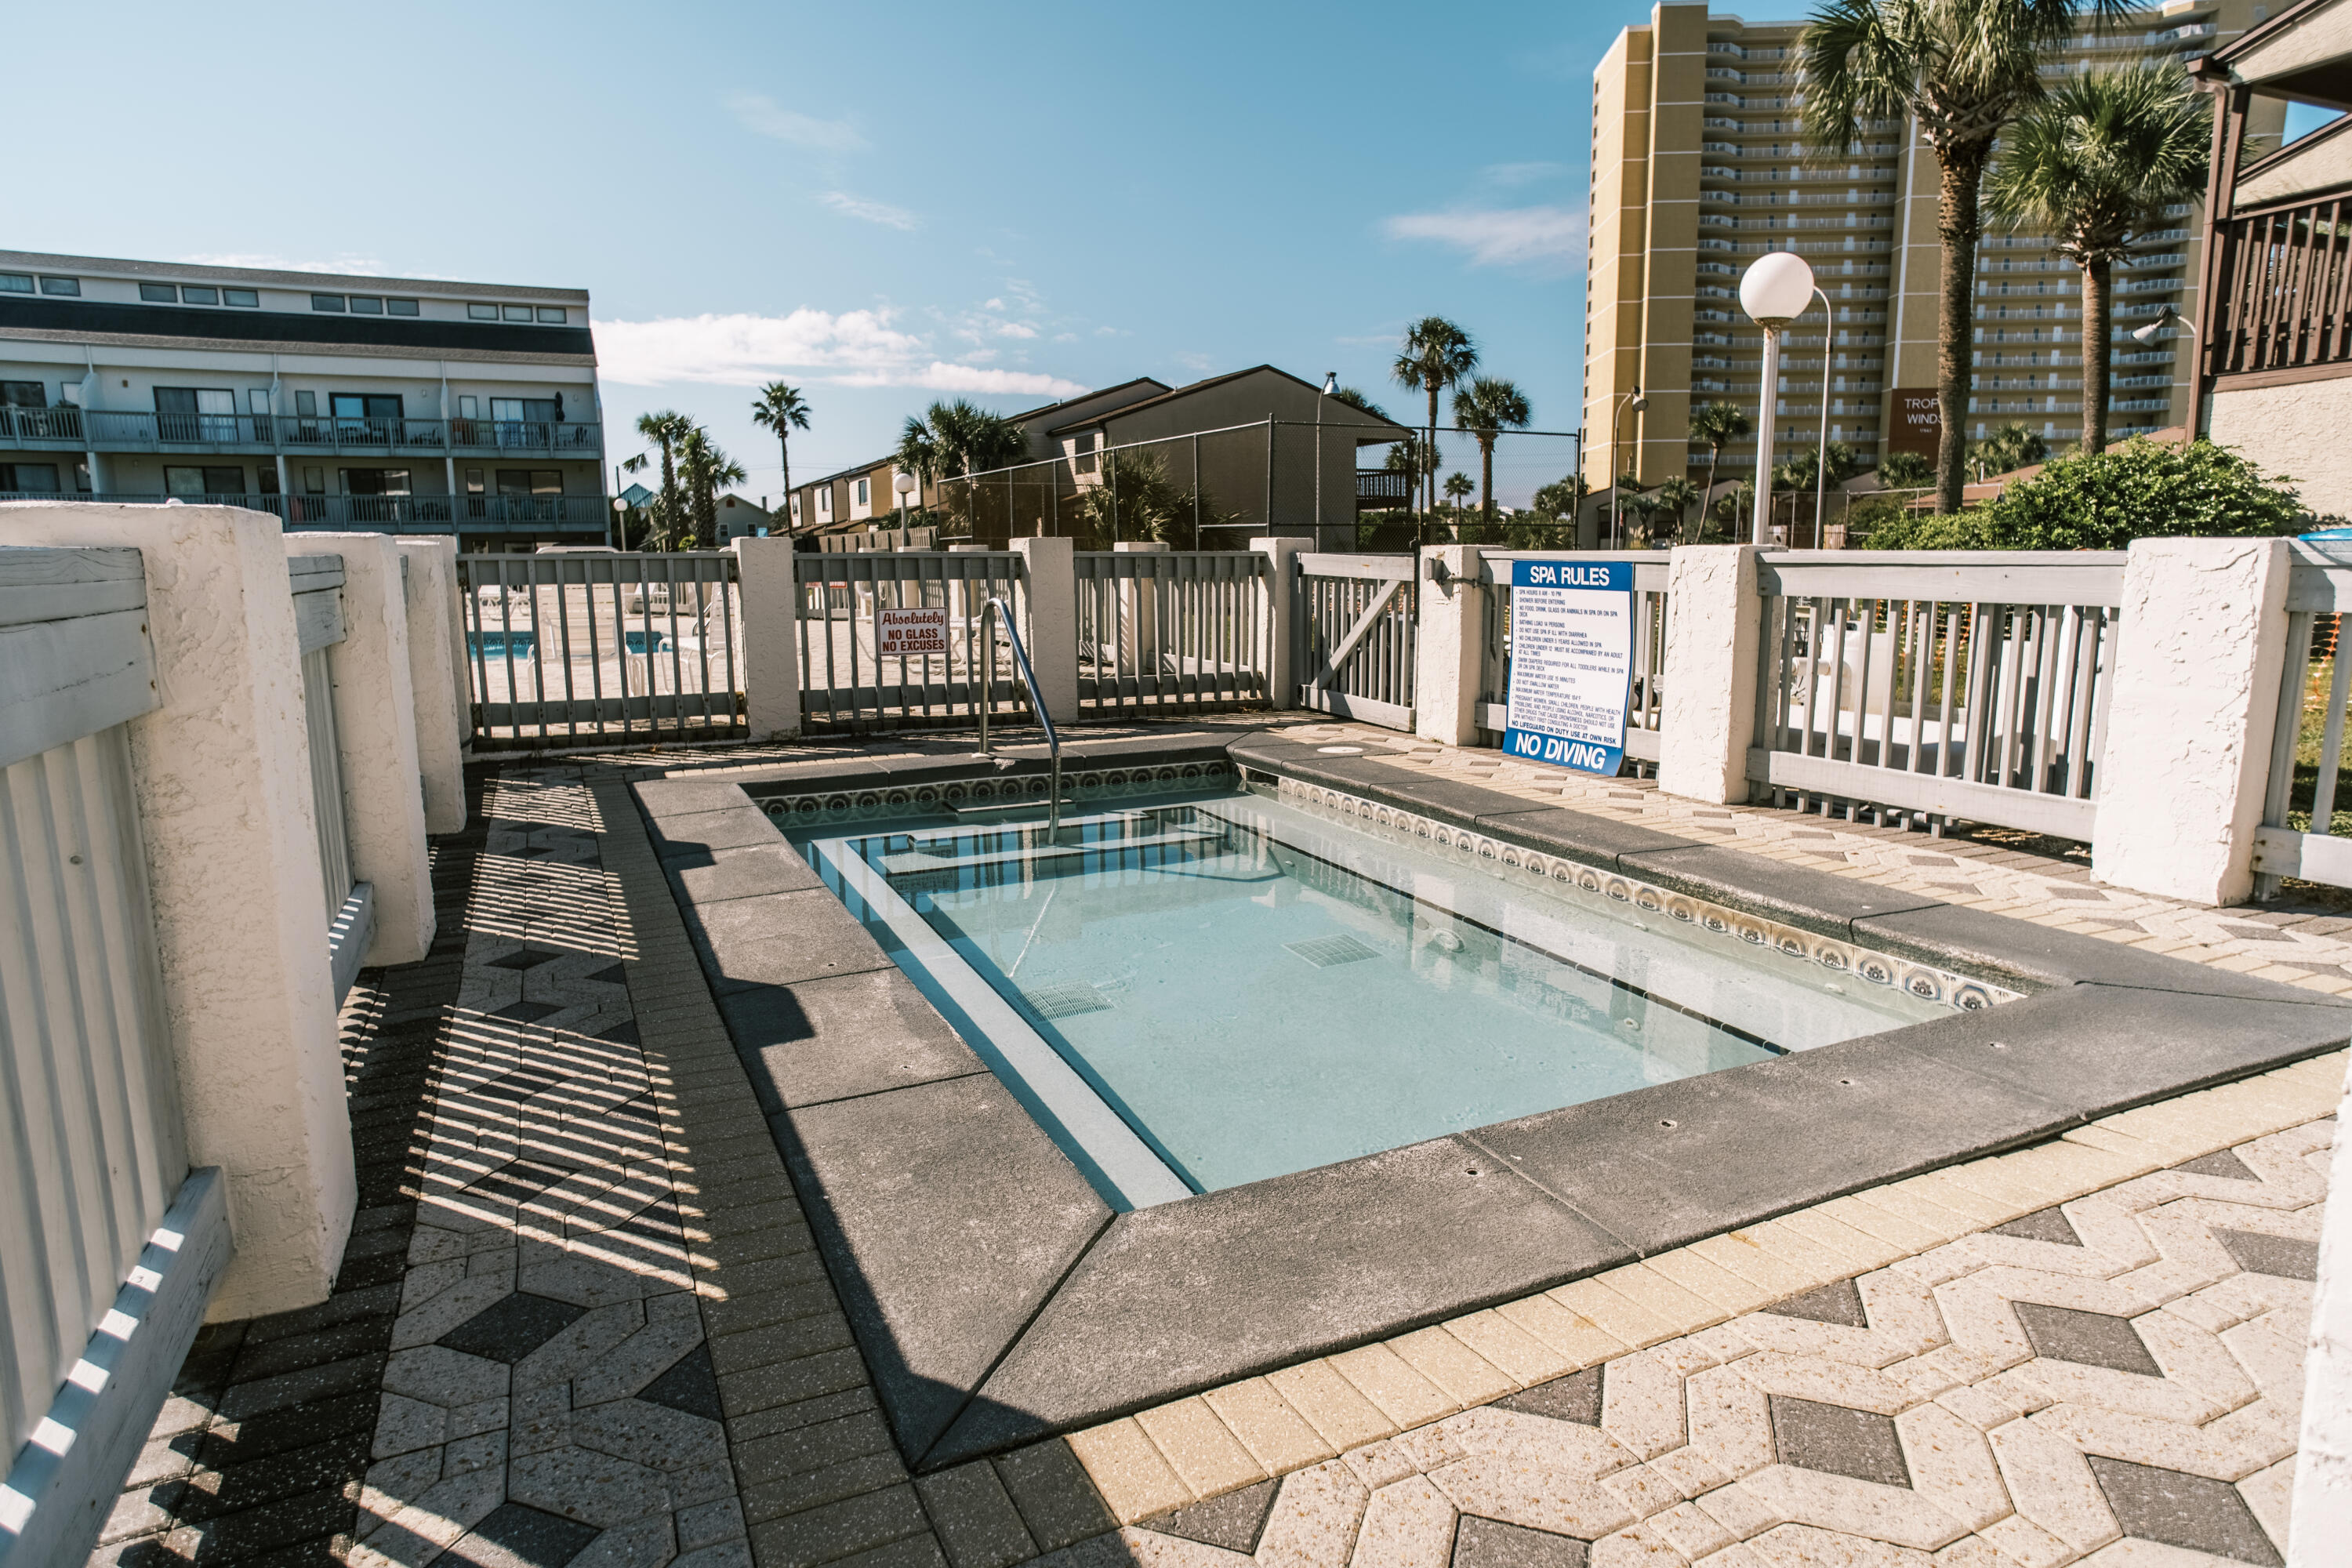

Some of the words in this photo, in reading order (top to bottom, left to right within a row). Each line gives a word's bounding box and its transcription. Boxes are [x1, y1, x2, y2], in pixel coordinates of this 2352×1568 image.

[1530, 566, 1556, 584] SPA
[1561, 567, 1610, 586] RULES
[882, 612, 943, 626] Absolutely
[888, 630, 902, 640] NO
[906, 628, 938, 639] GLASS
[883, 641, 896, 652] NO
[901, 640, 945, 651] EXCUSES
[1571, 648, 1597, 656] ACCOMPANIED
[1546, 691, 1570, 699] TEMPERATURE
[1548, 719, 1569, 728] CONSULTING
[1559, 714, 1581, 723] DROWSINESS
[1519, 721, 1545, 731] LIFEGUARD
[1604, 736, 1616, 745] RISK
[1515, 732, 1541, 756] NO
[1544, 738, 1606, 770] DIVING
